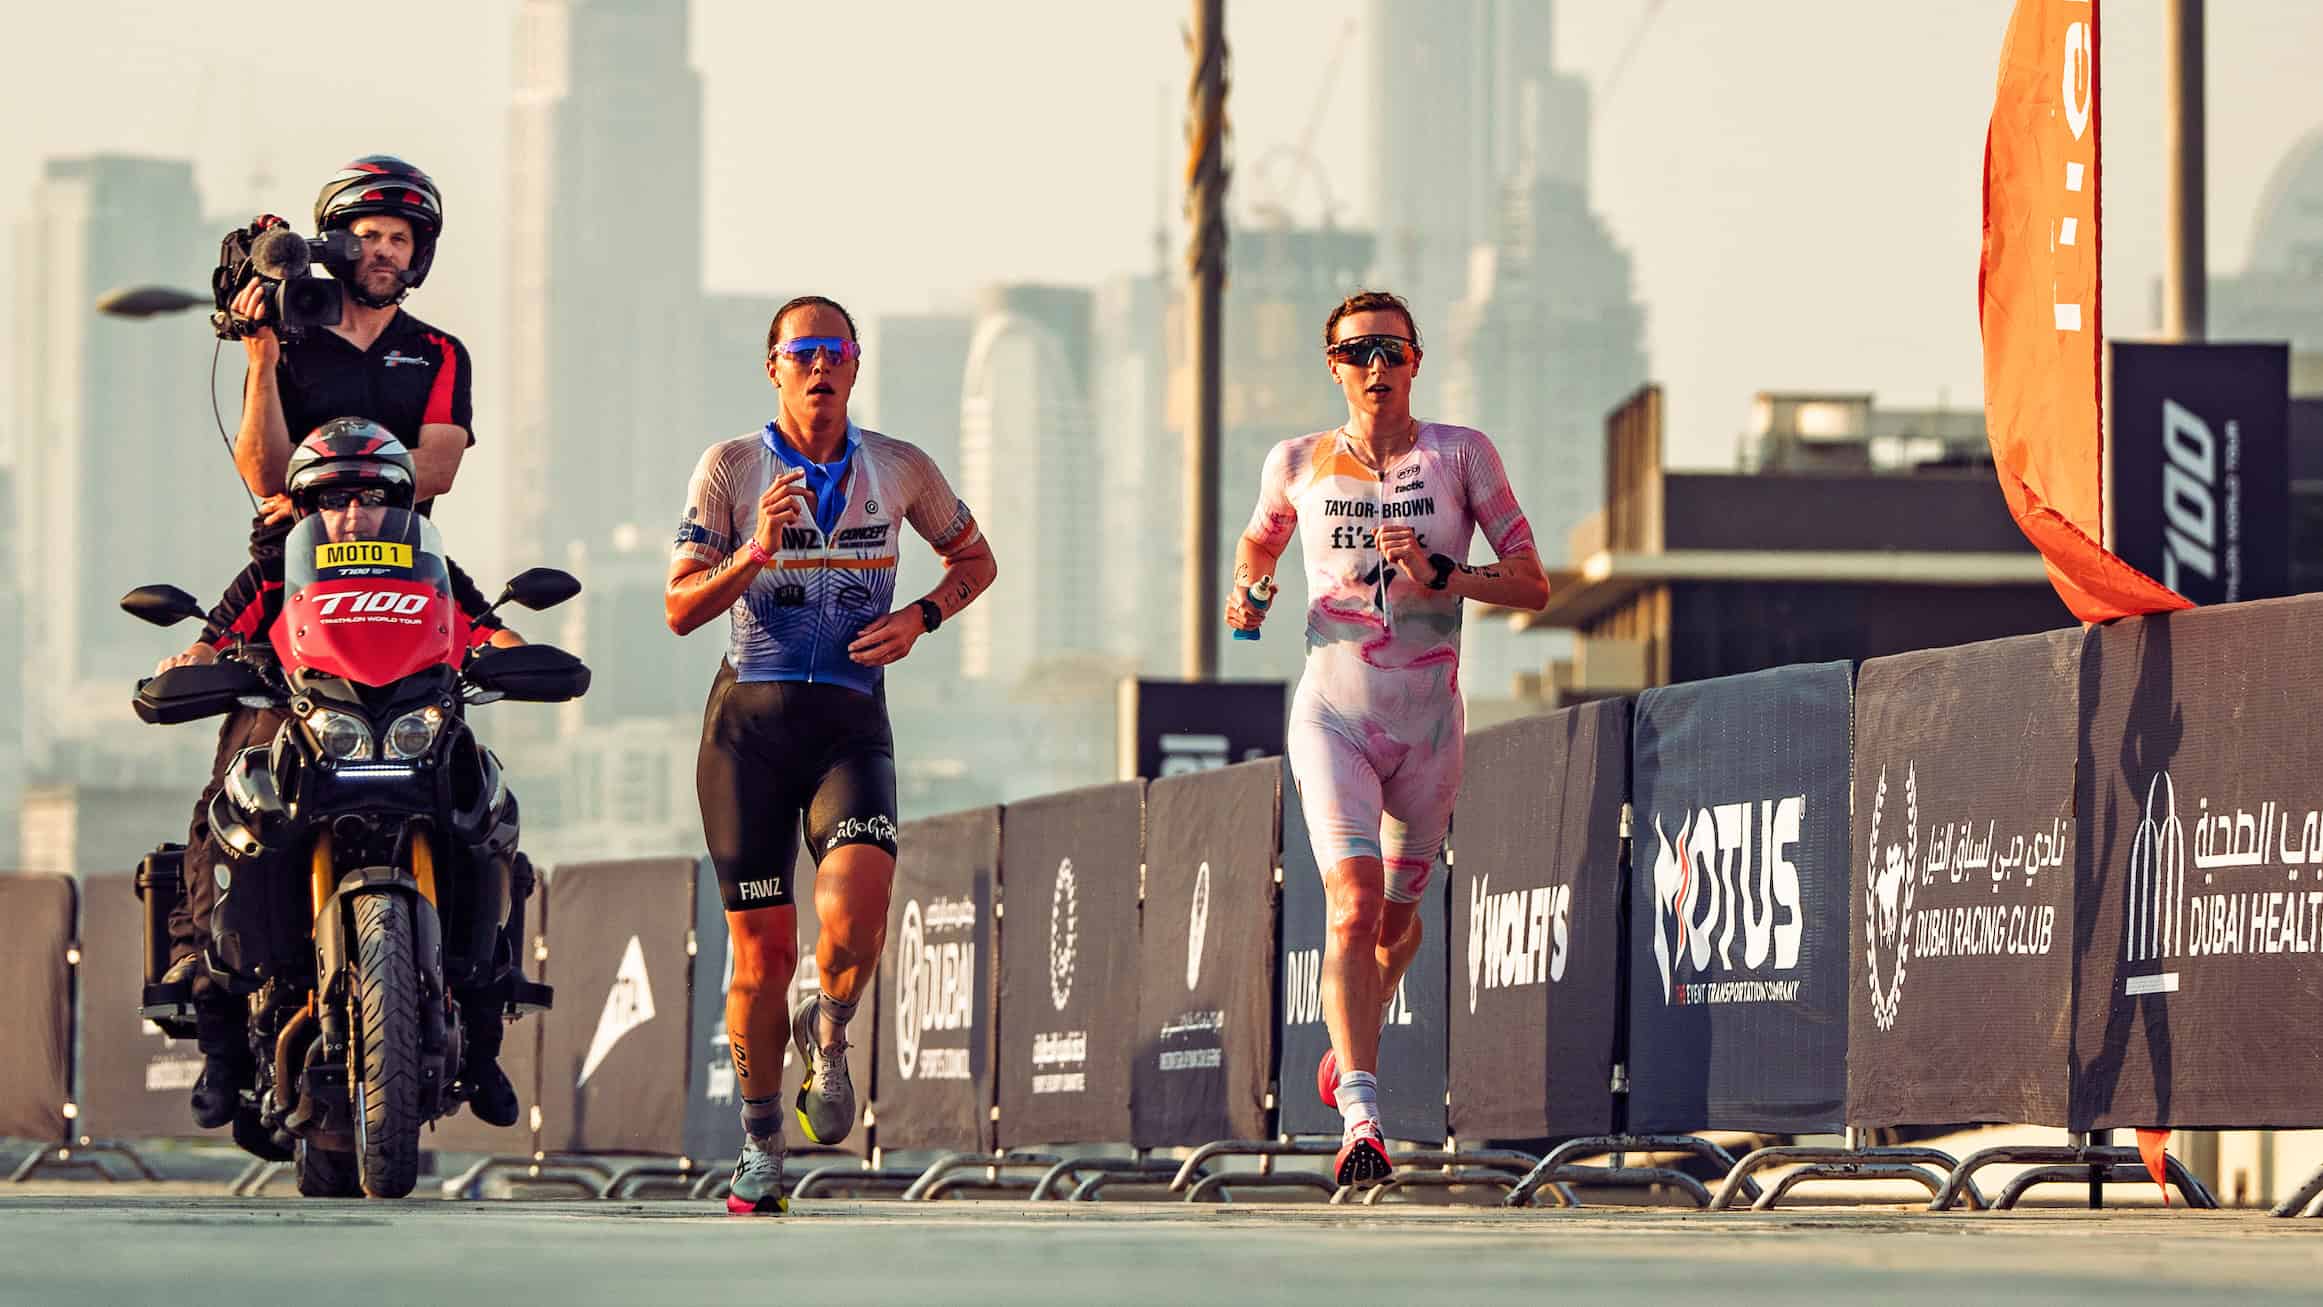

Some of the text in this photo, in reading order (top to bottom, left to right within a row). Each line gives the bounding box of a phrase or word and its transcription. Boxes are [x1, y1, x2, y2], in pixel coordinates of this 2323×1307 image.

[1395, 480, 1424, 493] tactic
[2163, 397, 2216, 594] 100
[839, 523, 890, 541] CONCEPT
[327, 545, 399, 563] MOTO 1
[312, 591, 429, 615] T100
[367, 615, 398, 623] WORLD
[1922, 816, 2067, 894] نادي دبي لسباق الخيل
[2194, 797, 2276, 886] الصحية
[739, 876, 783, 901] FAWZ
[1914, 904, 2055, 957] DUBAI RACING CLUB
[2189, 891, 2323, 957] DUBAI HEALT
[922, 941, 976, 1031] DUBAI
